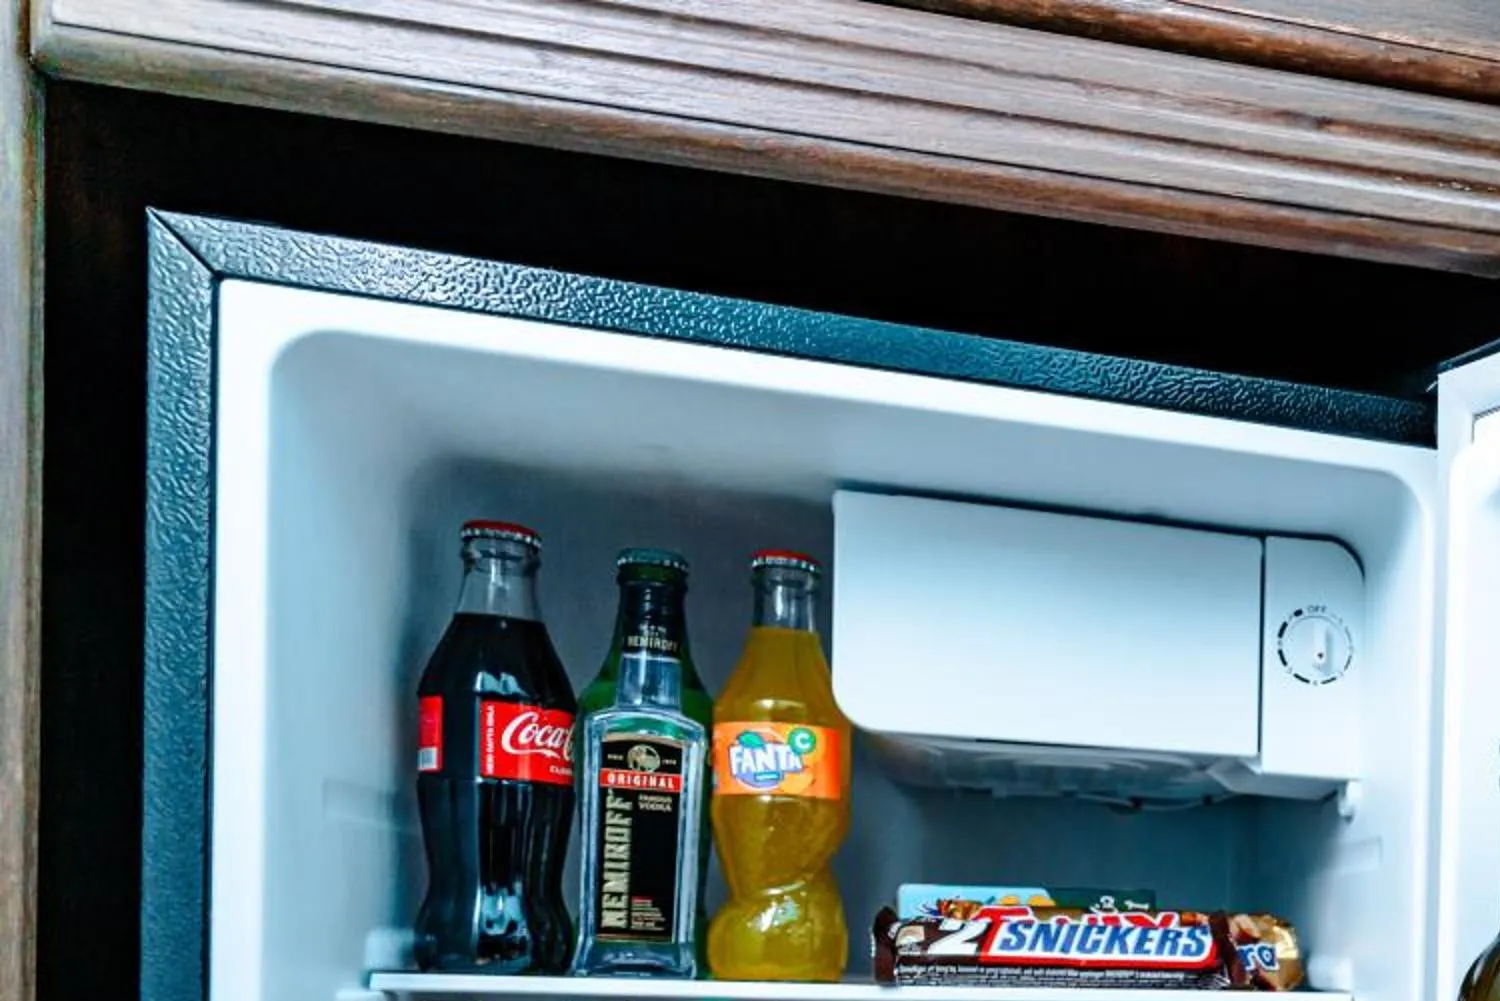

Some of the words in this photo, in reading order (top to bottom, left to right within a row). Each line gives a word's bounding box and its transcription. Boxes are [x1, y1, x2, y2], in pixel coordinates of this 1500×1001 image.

[729, 743, 804, 777] FANTA
[607, 772, 674, 789] ORIGINAL
[601, 793, 633, 928] NEMIROFF
[1001, 919, 1210, 957] SNICKERS
